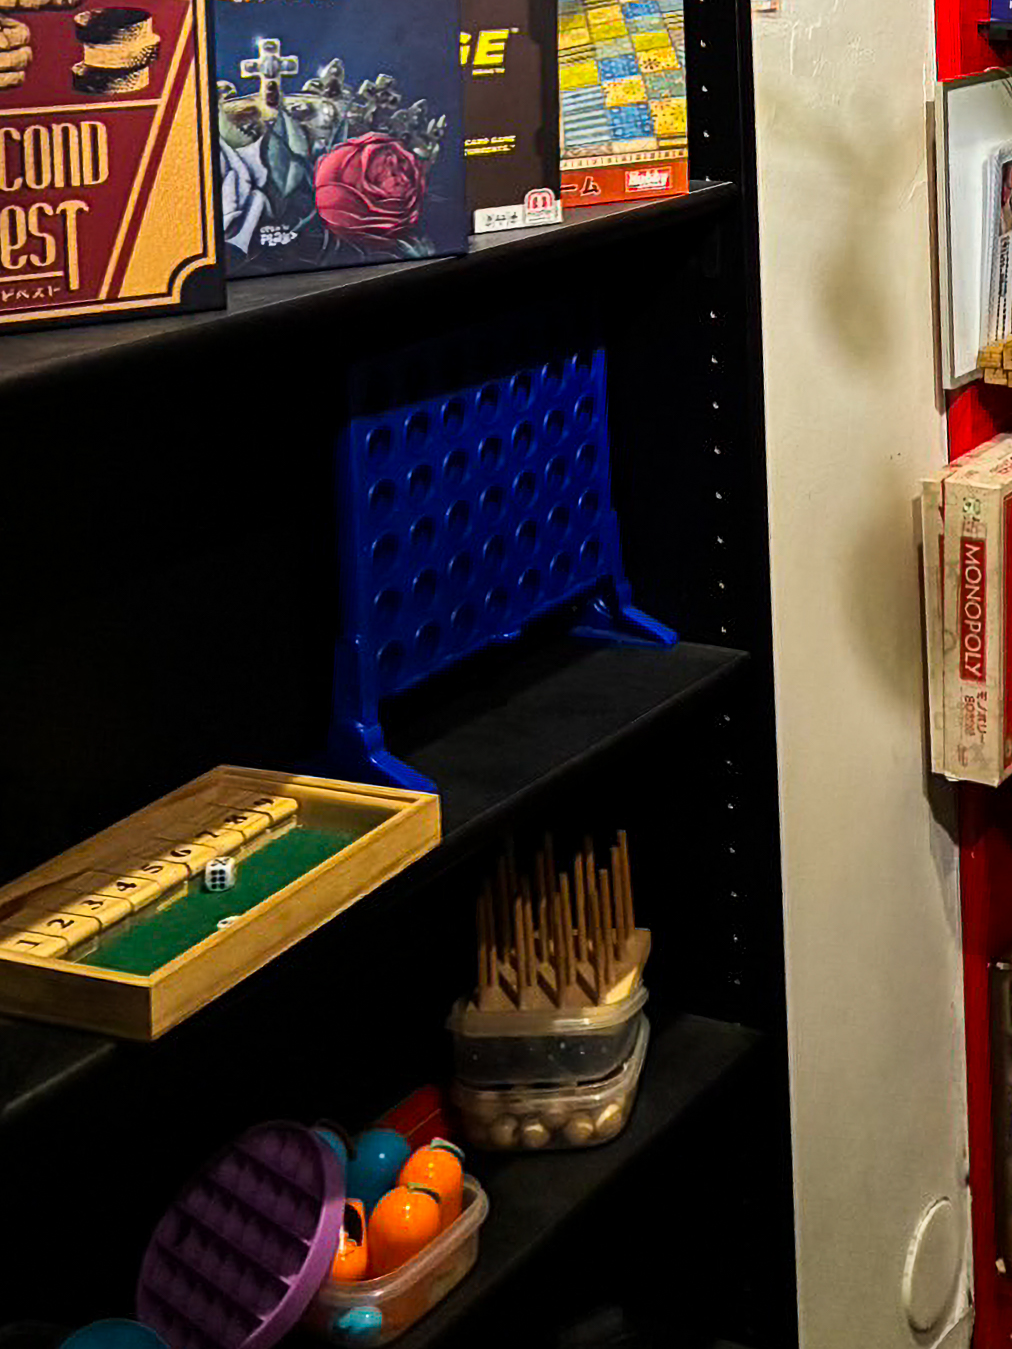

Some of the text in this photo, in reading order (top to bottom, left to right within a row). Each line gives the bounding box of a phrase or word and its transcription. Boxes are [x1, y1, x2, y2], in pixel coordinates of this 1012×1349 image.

[963, 542, 983, 681] MONOPOLY
[16, 797, 276, 950] 1 2 3 4 5 6 7 8 9
